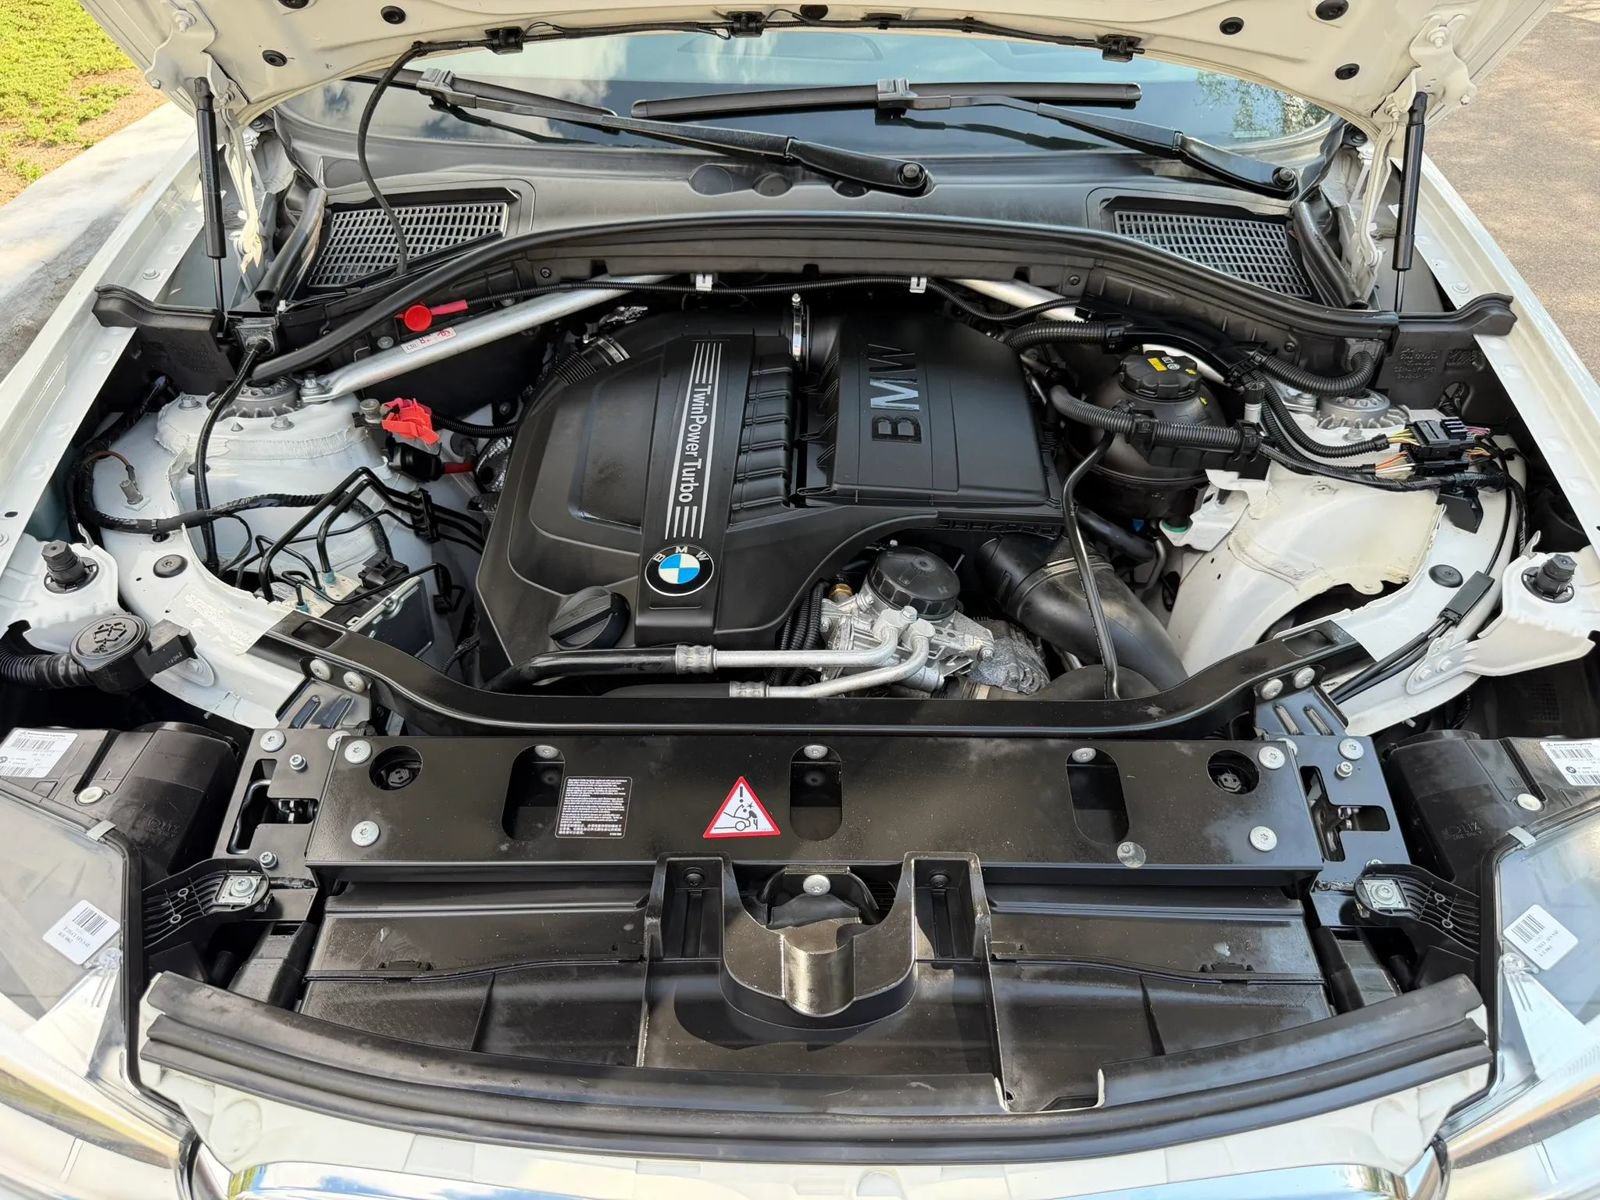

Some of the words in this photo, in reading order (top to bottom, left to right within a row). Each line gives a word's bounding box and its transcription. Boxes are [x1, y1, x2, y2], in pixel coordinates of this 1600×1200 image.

[867, 343, 922, 444] BMW
[678, 458, 702, 503] Turbo
[653, 546, 709, 563] BMW
